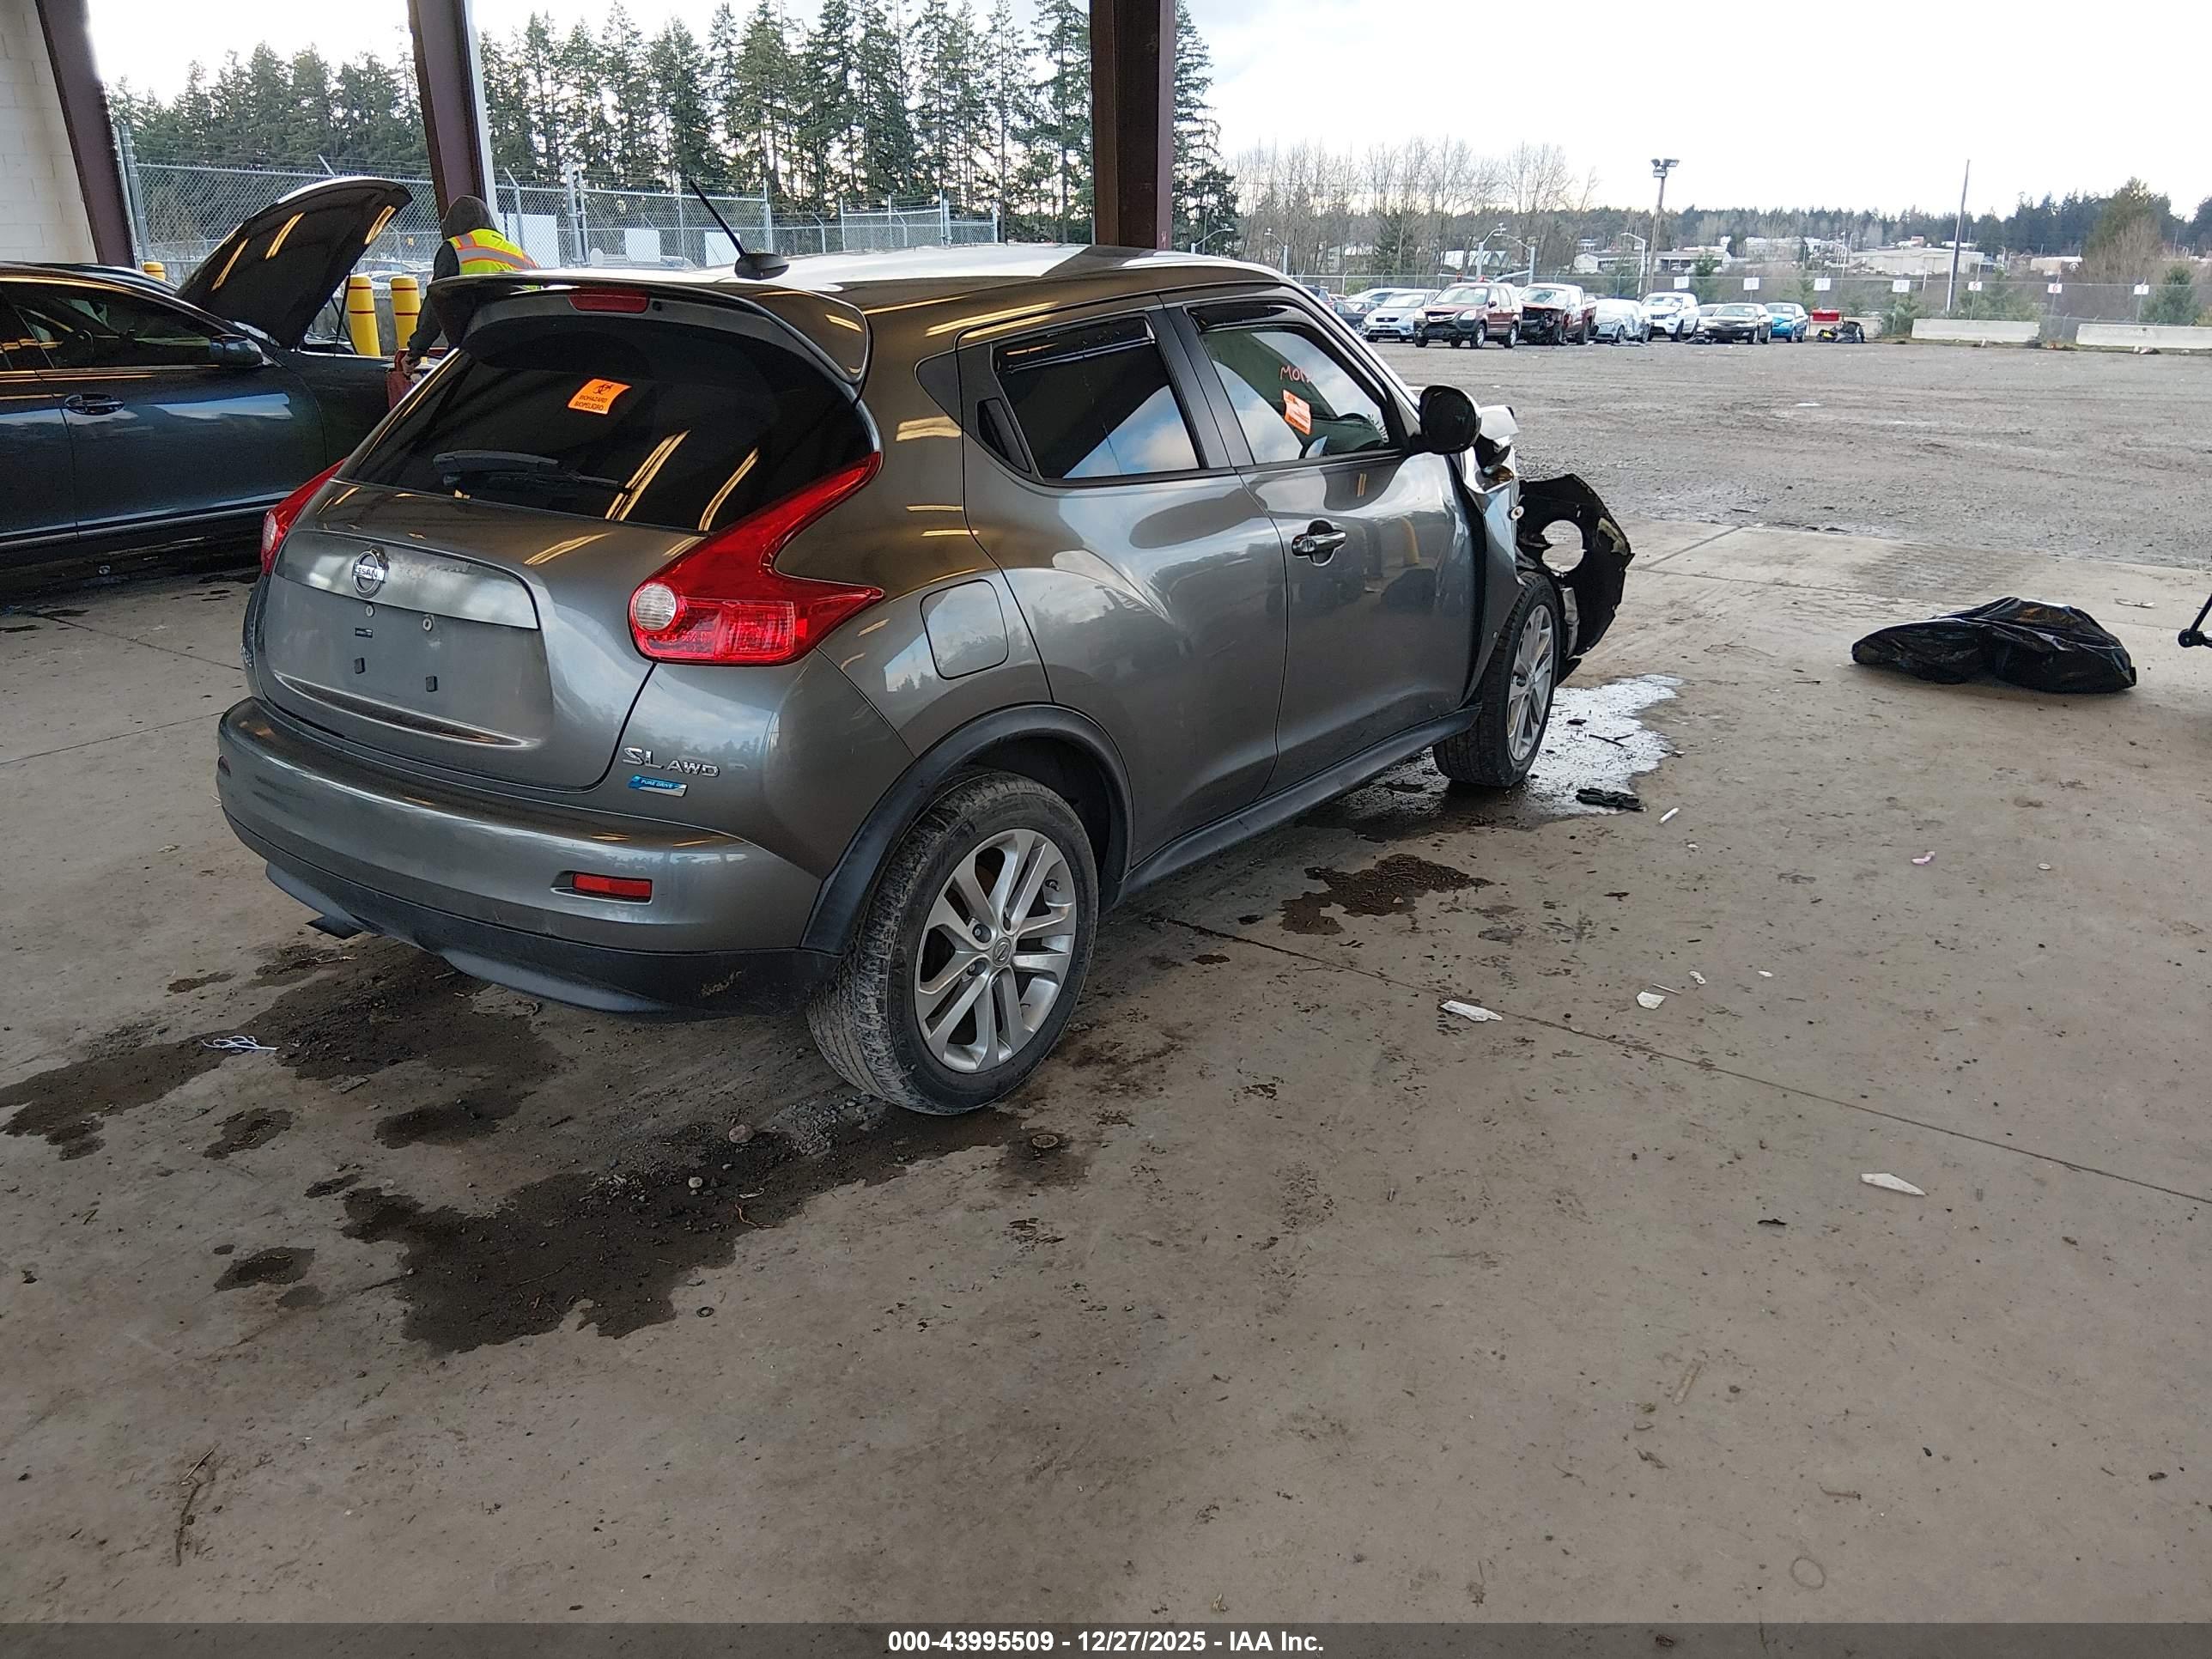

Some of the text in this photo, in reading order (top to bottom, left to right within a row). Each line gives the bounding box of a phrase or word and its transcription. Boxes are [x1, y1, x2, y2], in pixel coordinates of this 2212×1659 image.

[574, 401, 605, 410] BIOPELIGRO
[623, 747, 720, 777] SL AWD
